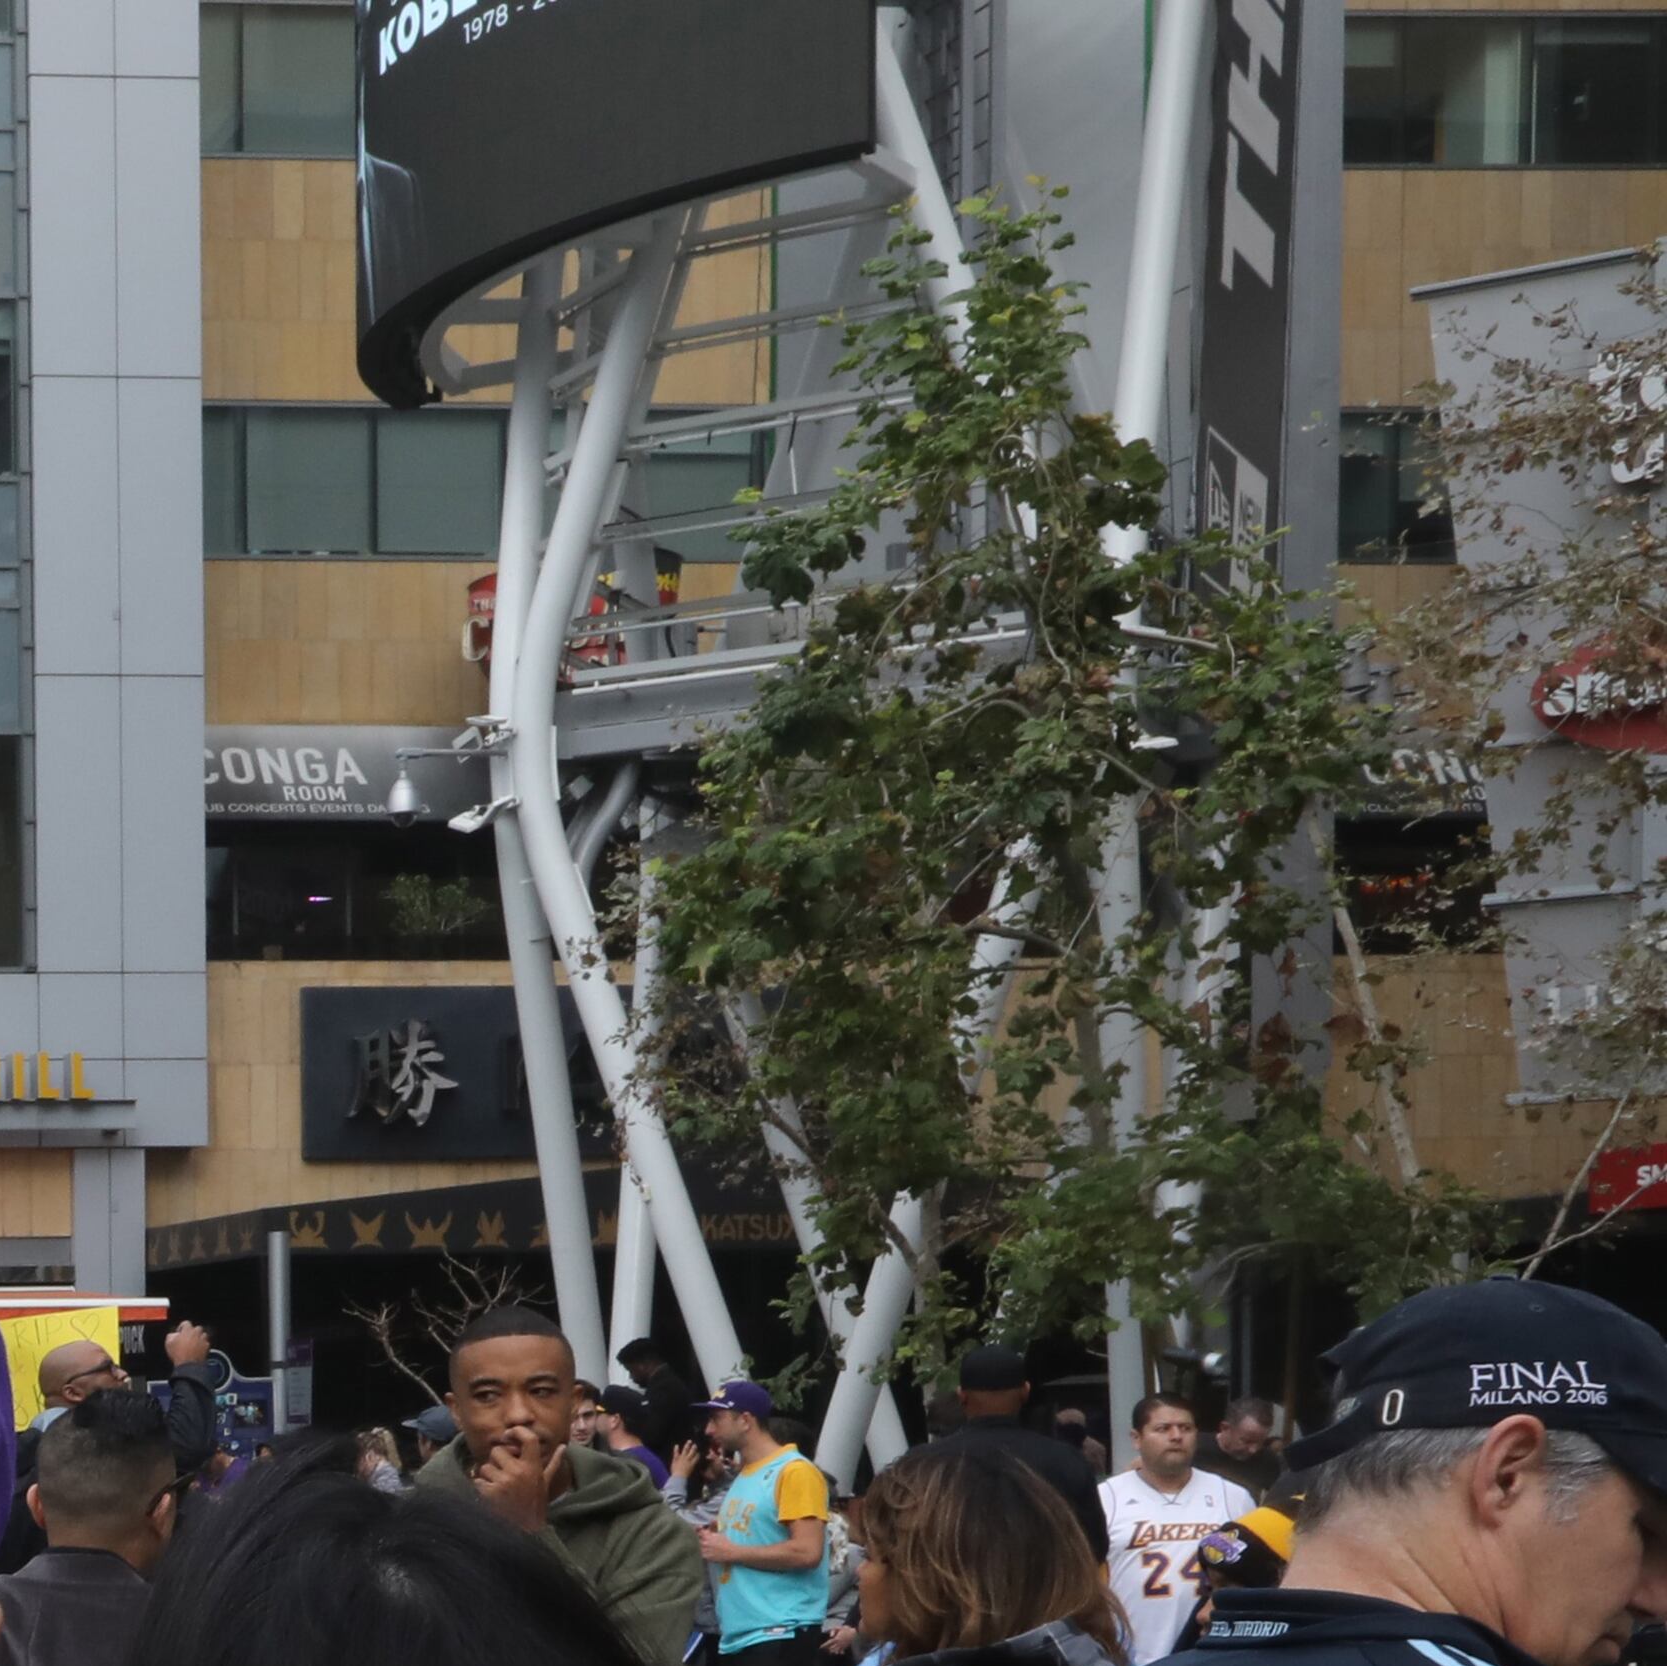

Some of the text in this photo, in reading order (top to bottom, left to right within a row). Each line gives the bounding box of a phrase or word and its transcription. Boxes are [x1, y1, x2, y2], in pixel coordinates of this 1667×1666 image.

[463, 3, 510, 45] 1978
[1221, 0, 1285, 290] TH
[283, 786, 347, 802] ROOM
[227, 803, 306, 814] CONCERTS
[310, 803, 364, 814] EVENTS
[11, 1317, 63, 1350] RIP
[1468, 1360, 1607, 1392] FINAL
[1468, 1387, 1608, 1408] MILANO 2016
[1232, 1620, 1290, 1638] MADRID
